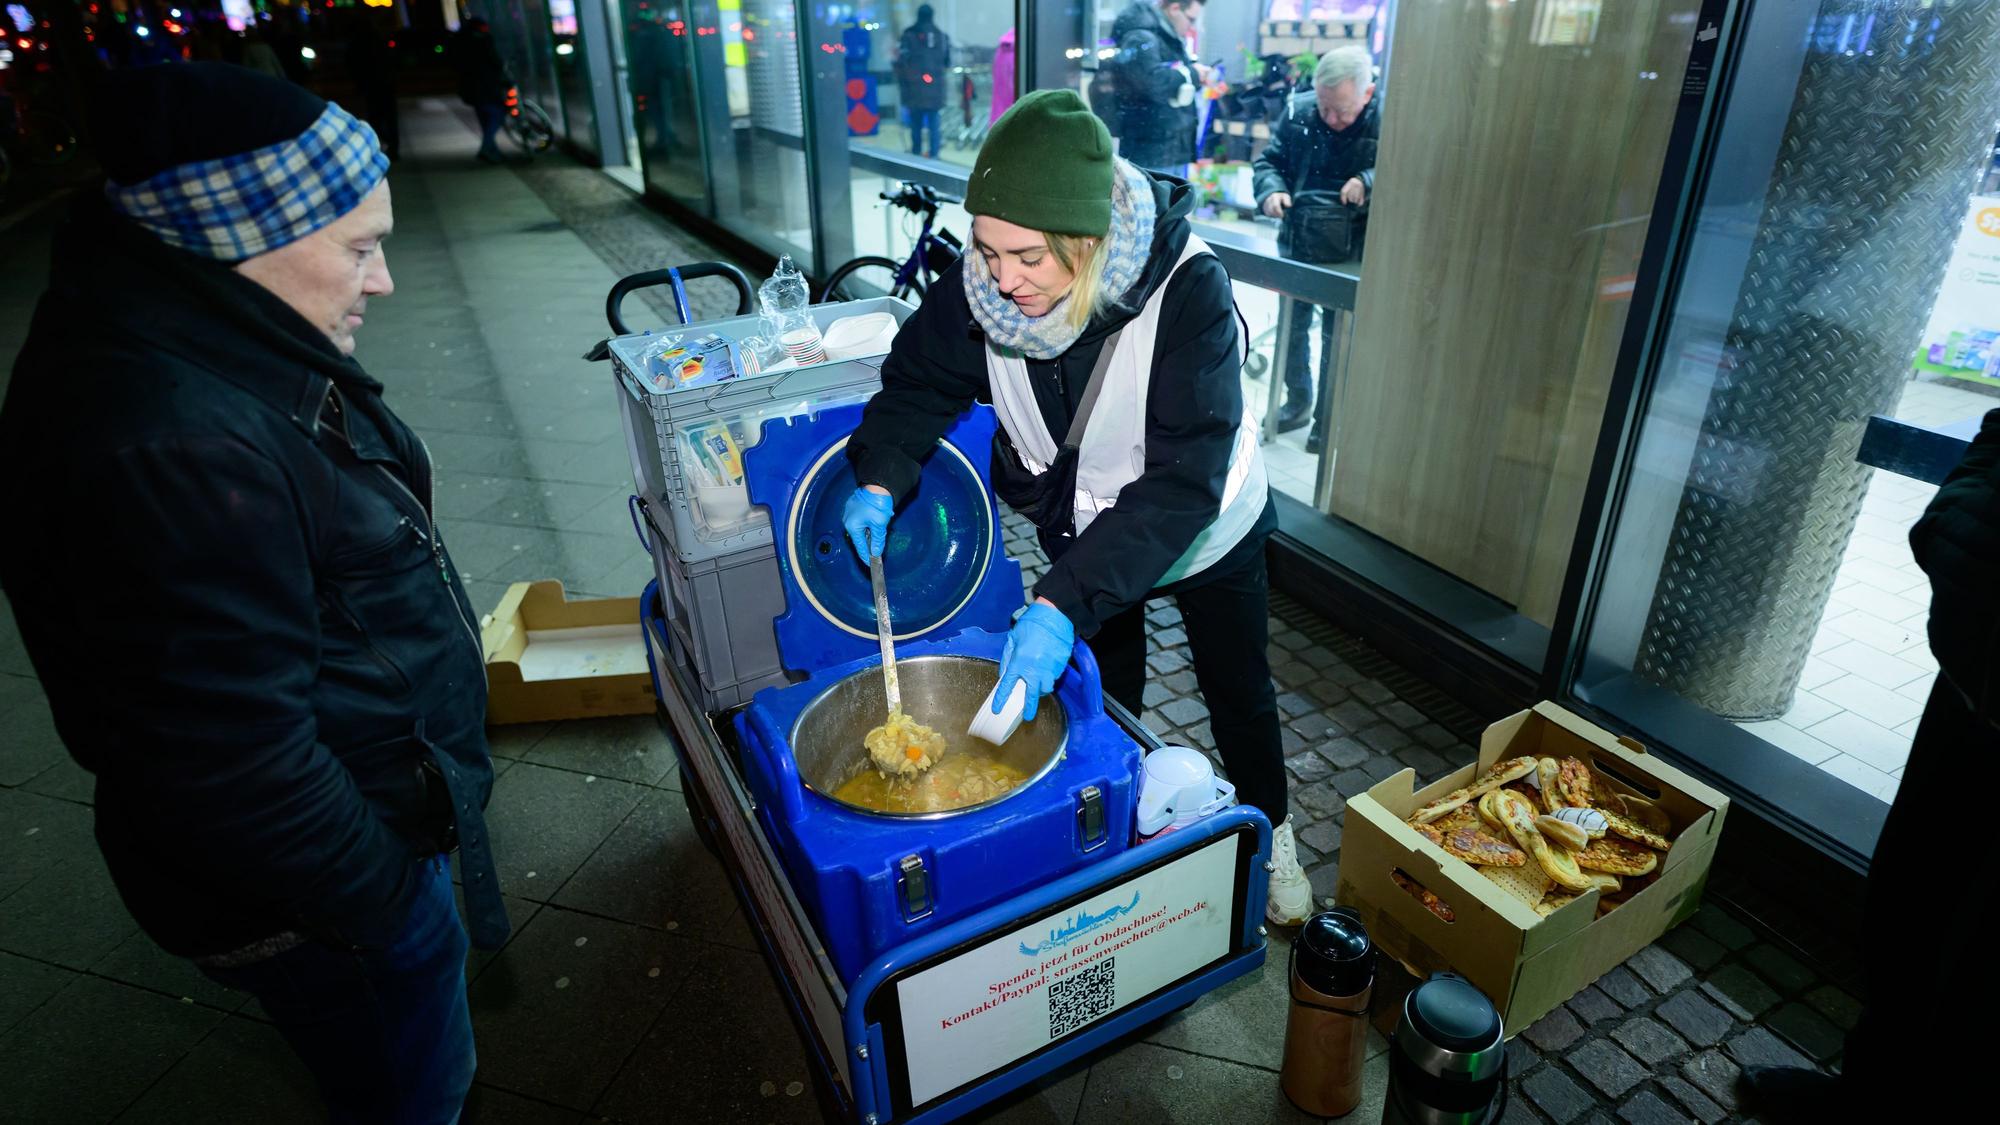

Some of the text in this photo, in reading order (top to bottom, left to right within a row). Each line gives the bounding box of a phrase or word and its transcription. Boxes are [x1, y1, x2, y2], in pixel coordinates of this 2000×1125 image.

[941, 901, 1208, 1030] Kontakt/Paypal: strassenwaechter@web.de
[989, 905, 1168, 995] Spende jetzt für Obdachlose!
